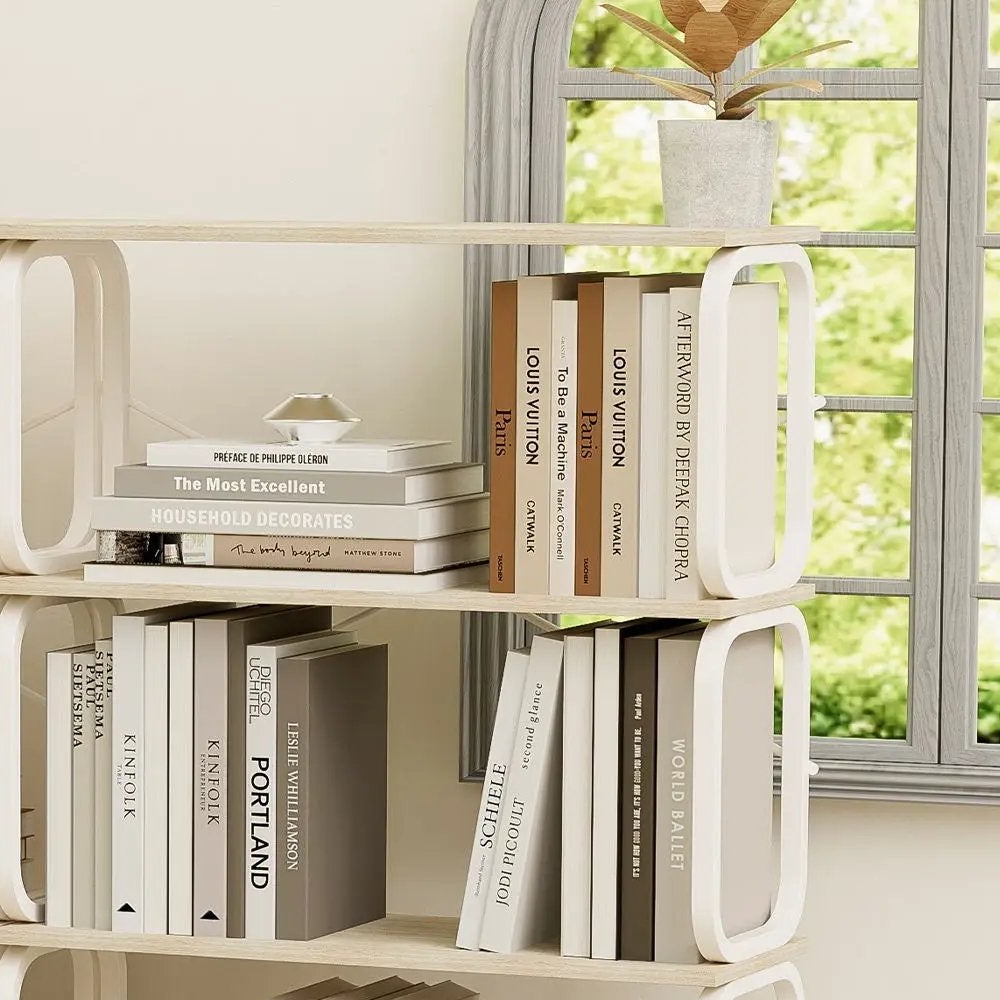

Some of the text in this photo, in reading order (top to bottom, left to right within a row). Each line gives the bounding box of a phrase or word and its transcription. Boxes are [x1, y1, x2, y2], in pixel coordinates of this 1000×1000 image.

[558, 367, 568, 382] To
[558, 388, 568, 406] Be
[495, 408, 512, 457] Paris
[526, 348, 540, 465] LOUIS VUITTON
[213, 452, 328, 464] PRÉFACE DE PHILIPPE OLÉRON
[557, 423, 568, 480] Machine
[674, 311, 692, 582] AFTERWORD BY DEEPAK CHOPRA
[174, 477, 325, 494] The Most Excellent
[151, 508, 354, 529] HOUSEHOLD DECORATES
[526, 501, 536, 553] CATWALK
[231, 543, 331, 563] The body beyond
[72, 664, 83, 748] SIETSEMA
[86, 665, 96, 708] PAUL
[248, 657, 260, 724] UCHITEL
[260, 666, 272, 716] DIEGO
[634, 708, 642, 720] Paul
[124, 735, 136, 819] KINFOLK
[208, 740, 220, 825] KINFOLK
[287, 722, 299, 871] LESLIE WHILLIAMSON
[251, 757, 269, 889] PORTLAND
[480, 763, 507, 849] SCHIELE
[671, 738, 686, 871] WORLD BALLET
